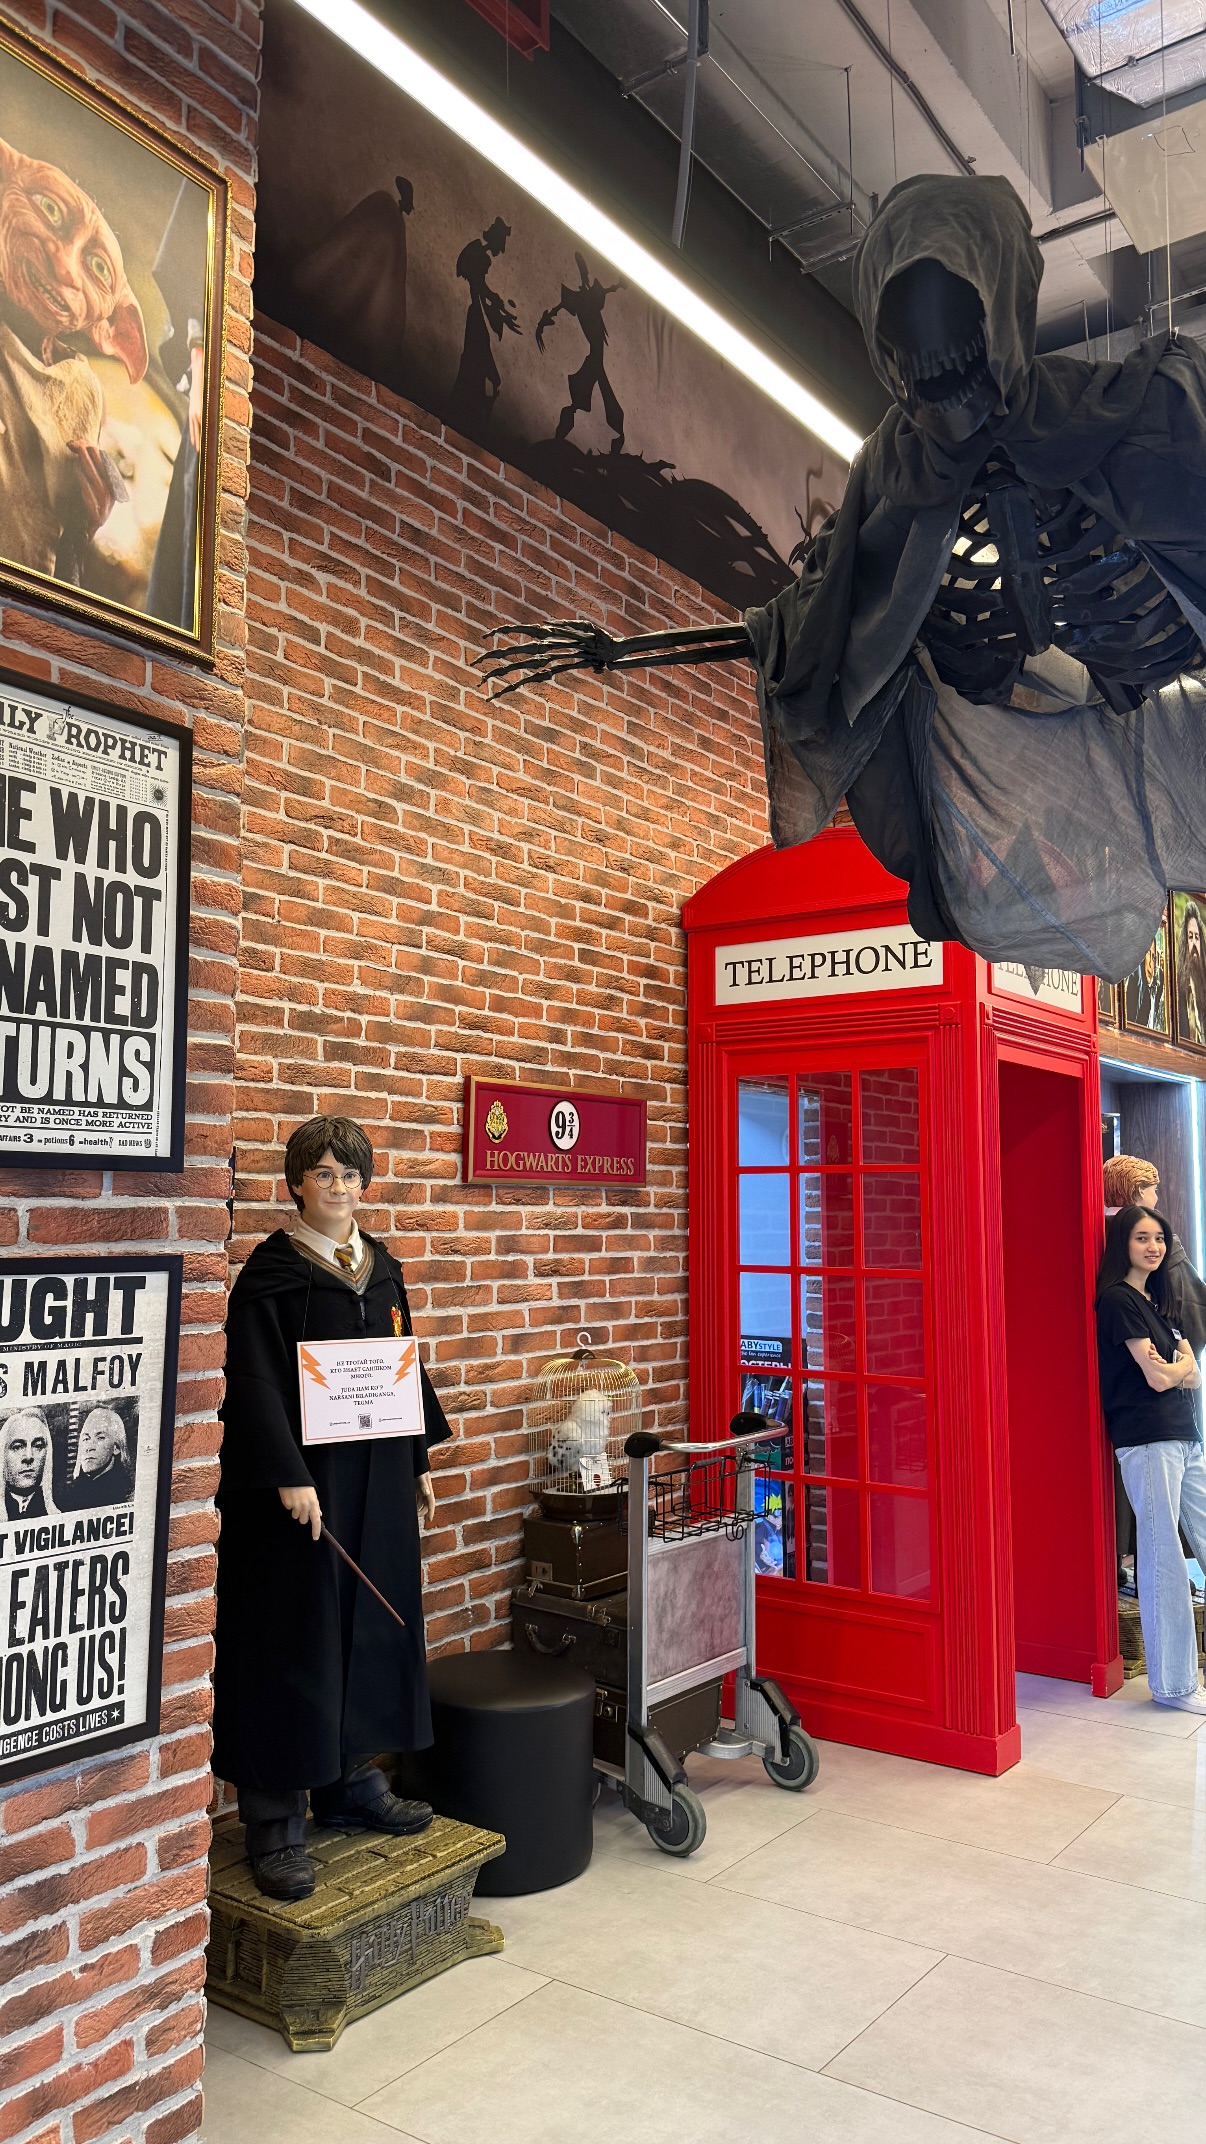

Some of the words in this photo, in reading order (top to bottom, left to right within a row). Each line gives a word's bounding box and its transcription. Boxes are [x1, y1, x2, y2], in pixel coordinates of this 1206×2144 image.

[49, 785, 162, 880] WHO
[72, 872, 162, 956] NOT
[724, 940, 934, 988] TELEPHONE
[13, 1115, 38, 1124] AND
[40, 1116, 51, 1125] IS
[53, 1117, 83, 1126] ONCE
[85, 1119, 115, 1128] MORE
[117, 1121, 153, 1130] ACTIVE
[20, 1106, 35, 1114] BE
[37, 1107, 75, 1117] NAMED
[77, 1109, 99, 1118] HAS
[102, 1111, 153, 1121] RETURNED
[23, 1133, 34, 1144] 3
[485, 1150, 572, 1173] HOGWARTS
[577, 1154, 635, 1176] EXPRESS
[23, 1352, 143, 1397] MALFOY
[14, 1511, 135, 1556] VIGILANCE!
[8, 1550, 130, 1649] EATERS
[0, 1641, 69, 1729] ONG
[76, 1626, 127, 1707] US!
[43, 1718, 77, 1744] COSTS
[79, 1709, 108, 1733] LIVES
